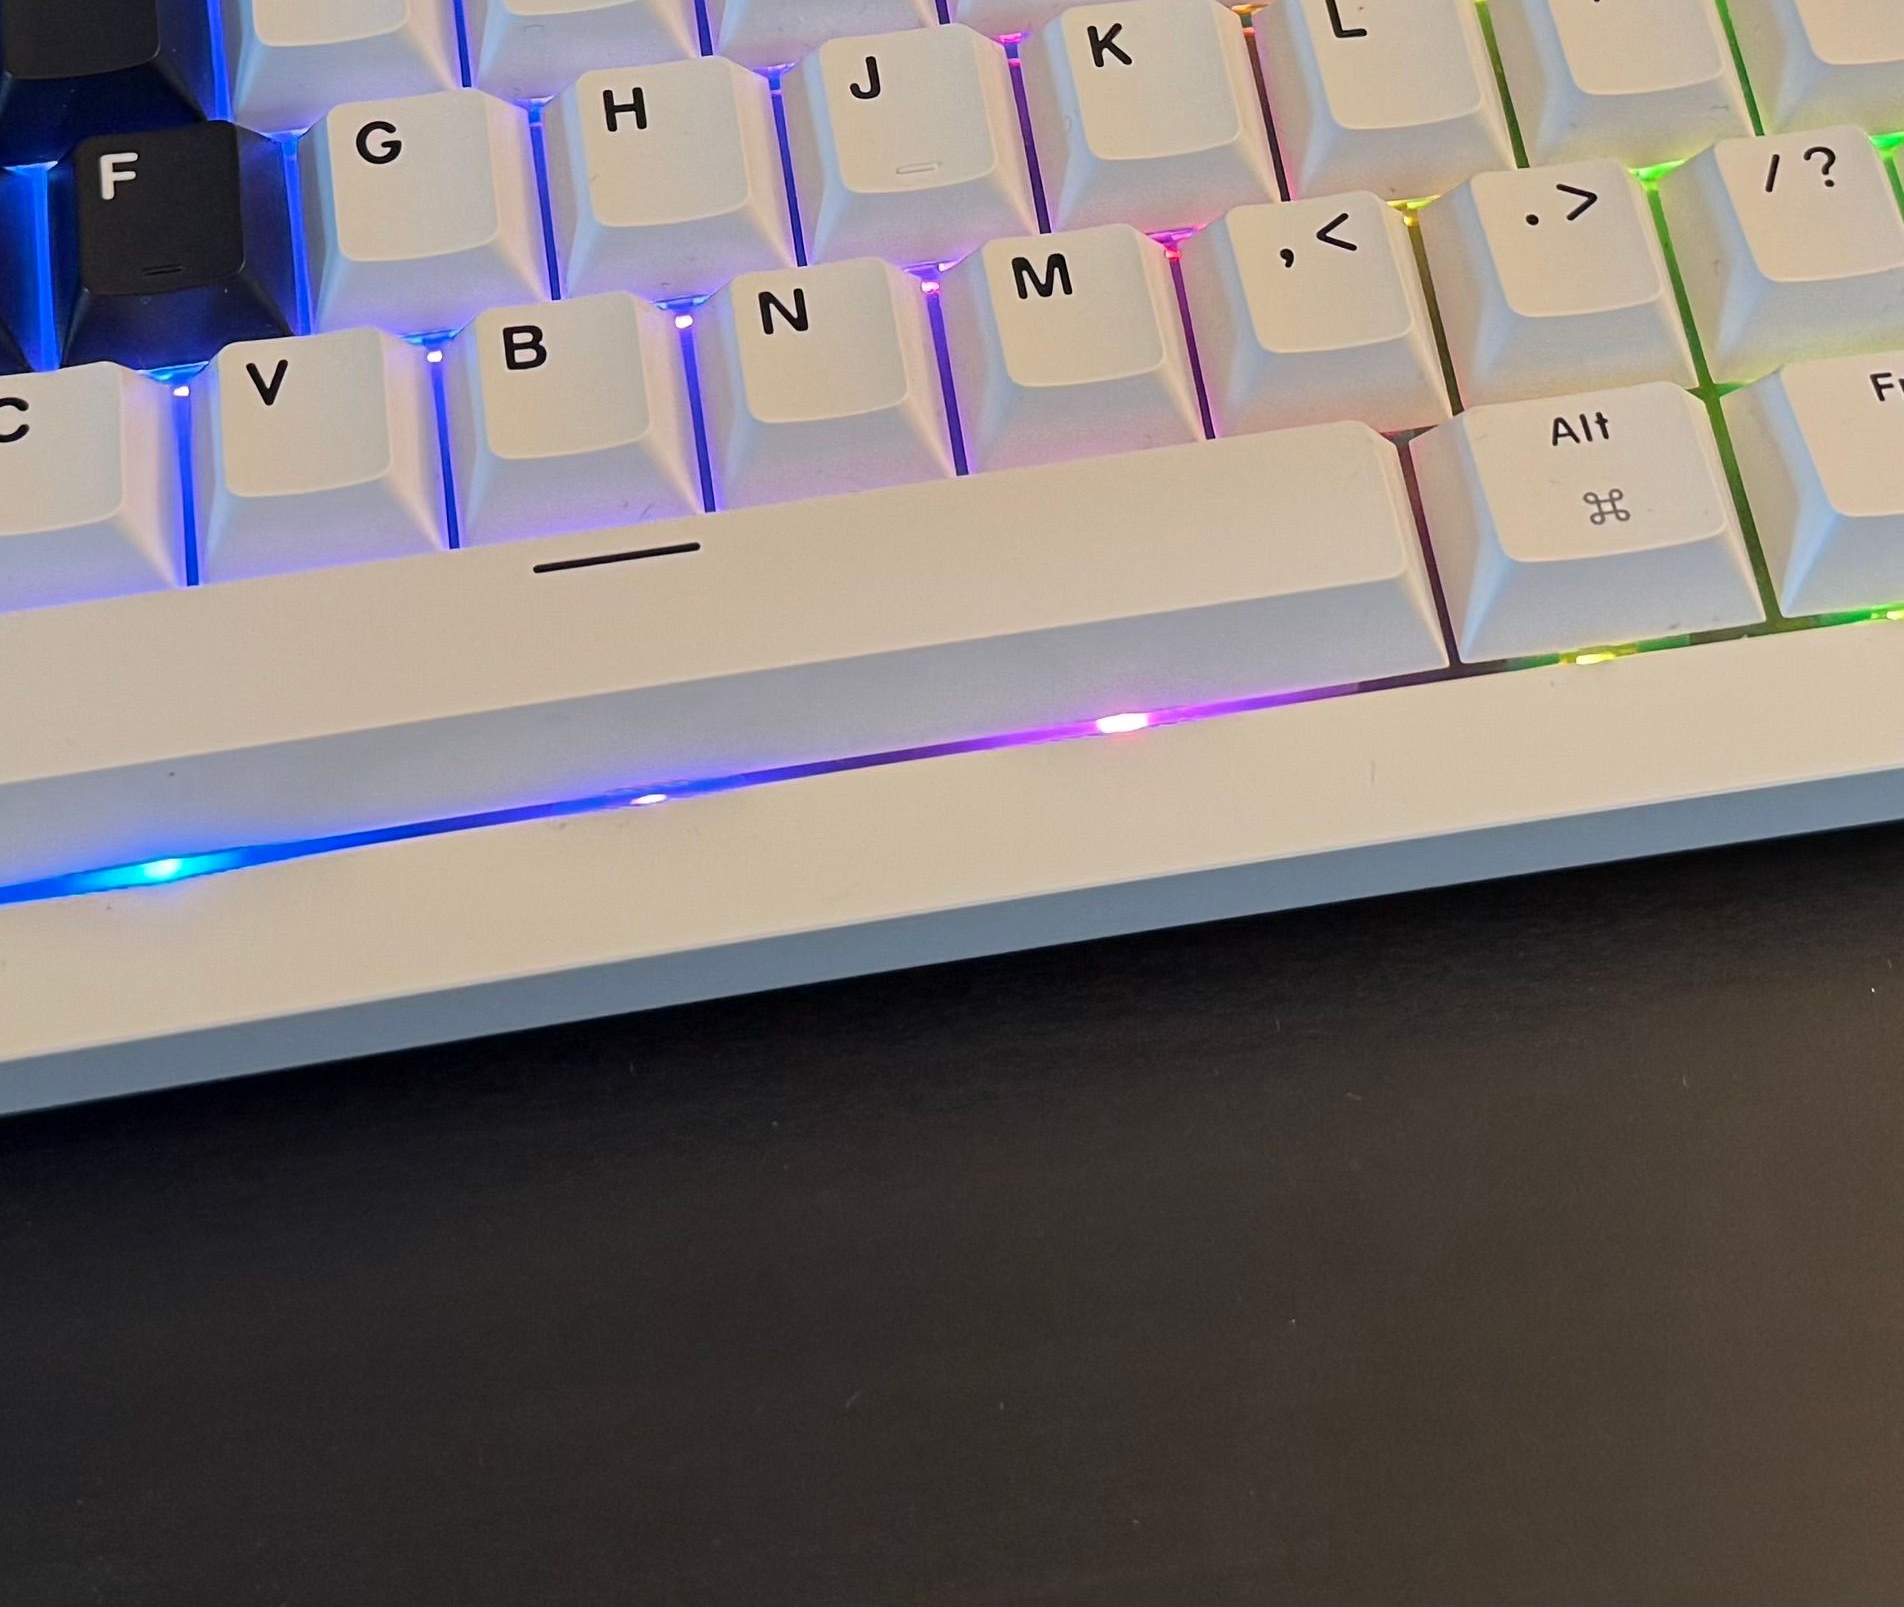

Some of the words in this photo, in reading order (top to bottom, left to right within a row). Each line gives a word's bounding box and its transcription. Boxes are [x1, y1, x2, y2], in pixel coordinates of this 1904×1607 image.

[1086, 22, 1133, 68] K
[849, 55, 882, 100] J
[602, 86, 648, 133] H
[355, 120, 403, 165] G
[99, 152, 139, 201] F
[1011, 252, 1073, 300] M
[757, 287, 809, 336] N
[502, 324, 548, 371] B
[245, 359, 289, 407] V
[1551, 411, 1610, 447] Alt
